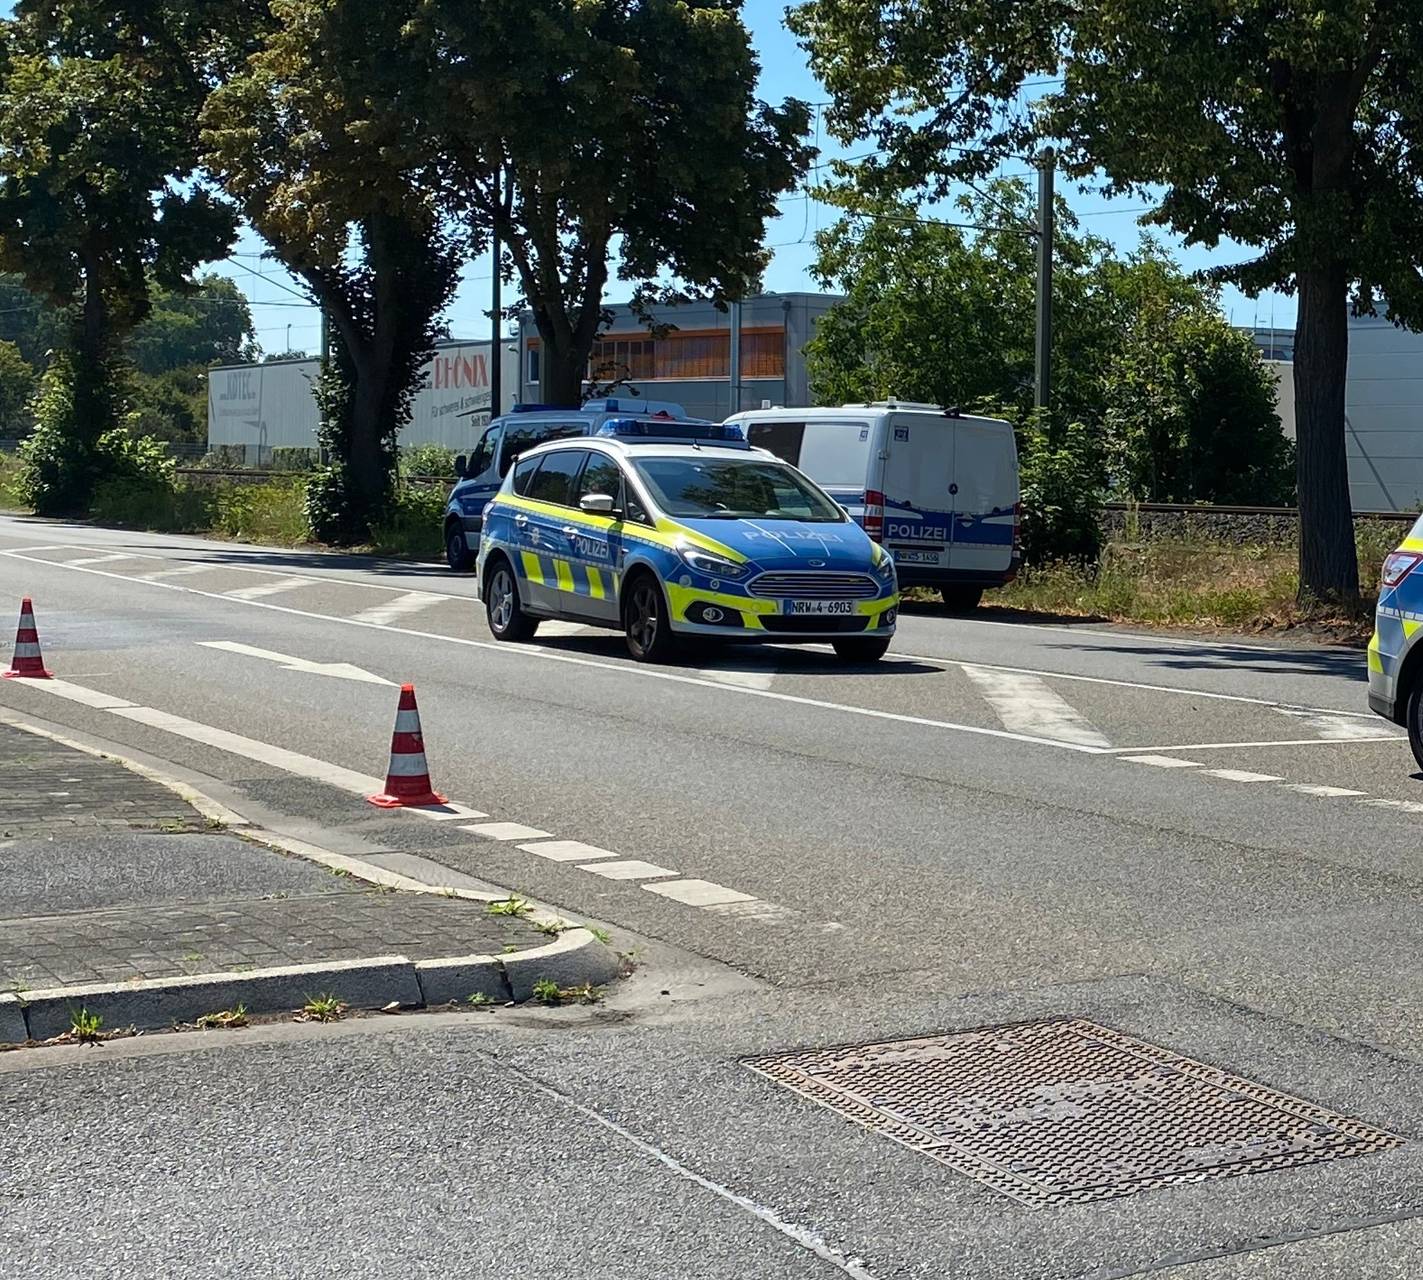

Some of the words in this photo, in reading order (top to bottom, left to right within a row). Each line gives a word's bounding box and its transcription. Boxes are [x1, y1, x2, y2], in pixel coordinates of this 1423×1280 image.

[741, 530, 844, 543] POLIZEI
[887, 523, 947, 540] POLIZEI
[573, 536, 611, 559] POLIZEI
[791, 601, 812, 614] NRW
